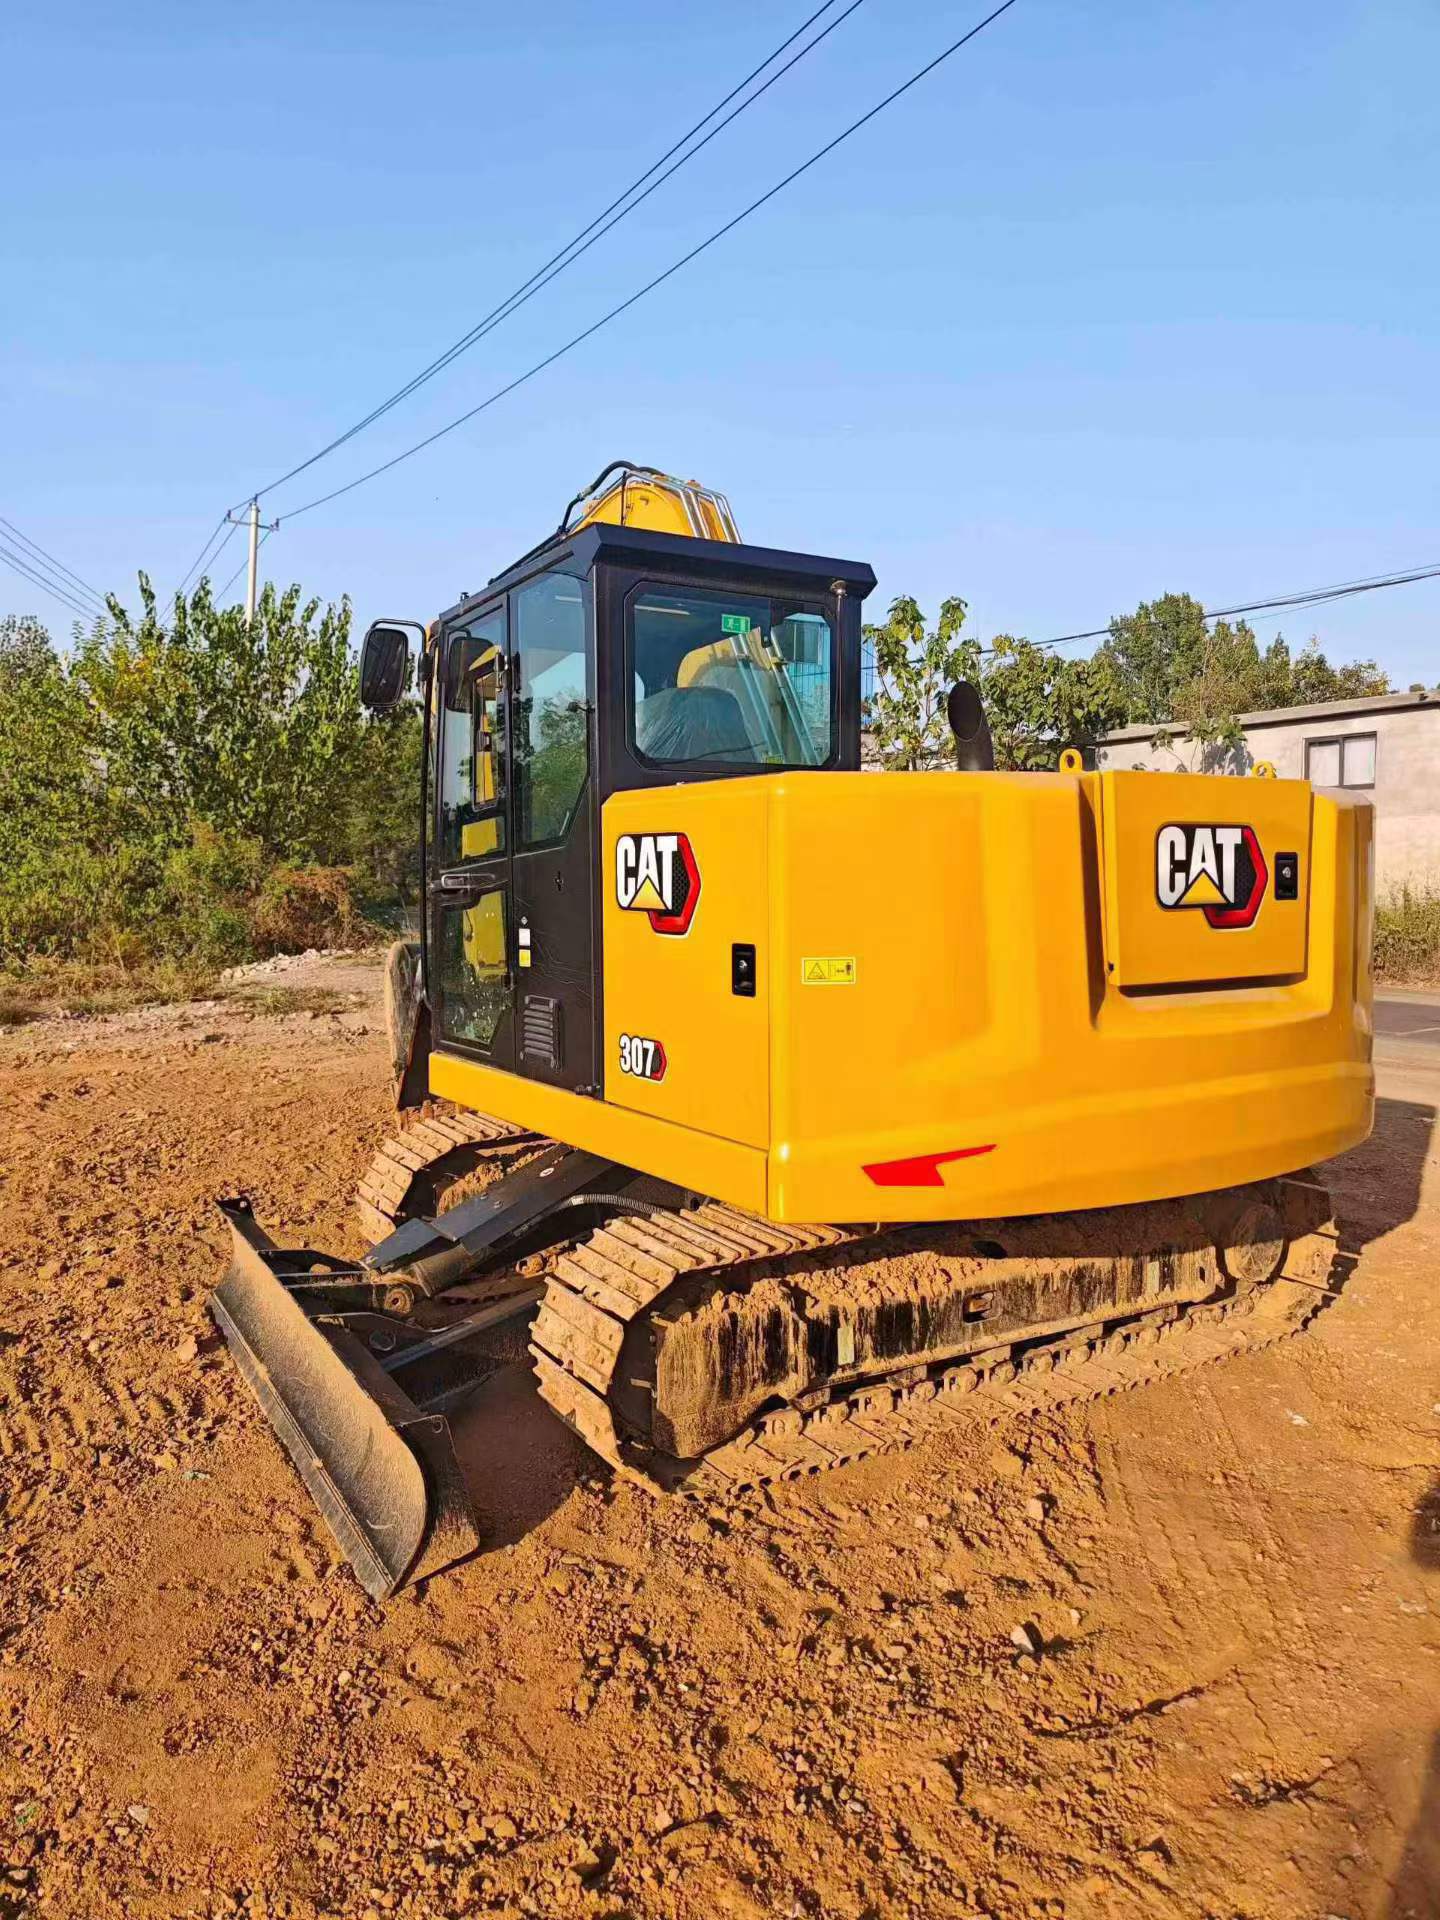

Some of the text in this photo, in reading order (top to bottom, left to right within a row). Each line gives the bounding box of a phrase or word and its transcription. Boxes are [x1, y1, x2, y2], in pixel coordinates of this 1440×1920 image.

[616, 835, 678, 911] CAT
[1157, 825, 1242, 906] CAT
[619, 1035, 655, 1077] 307
